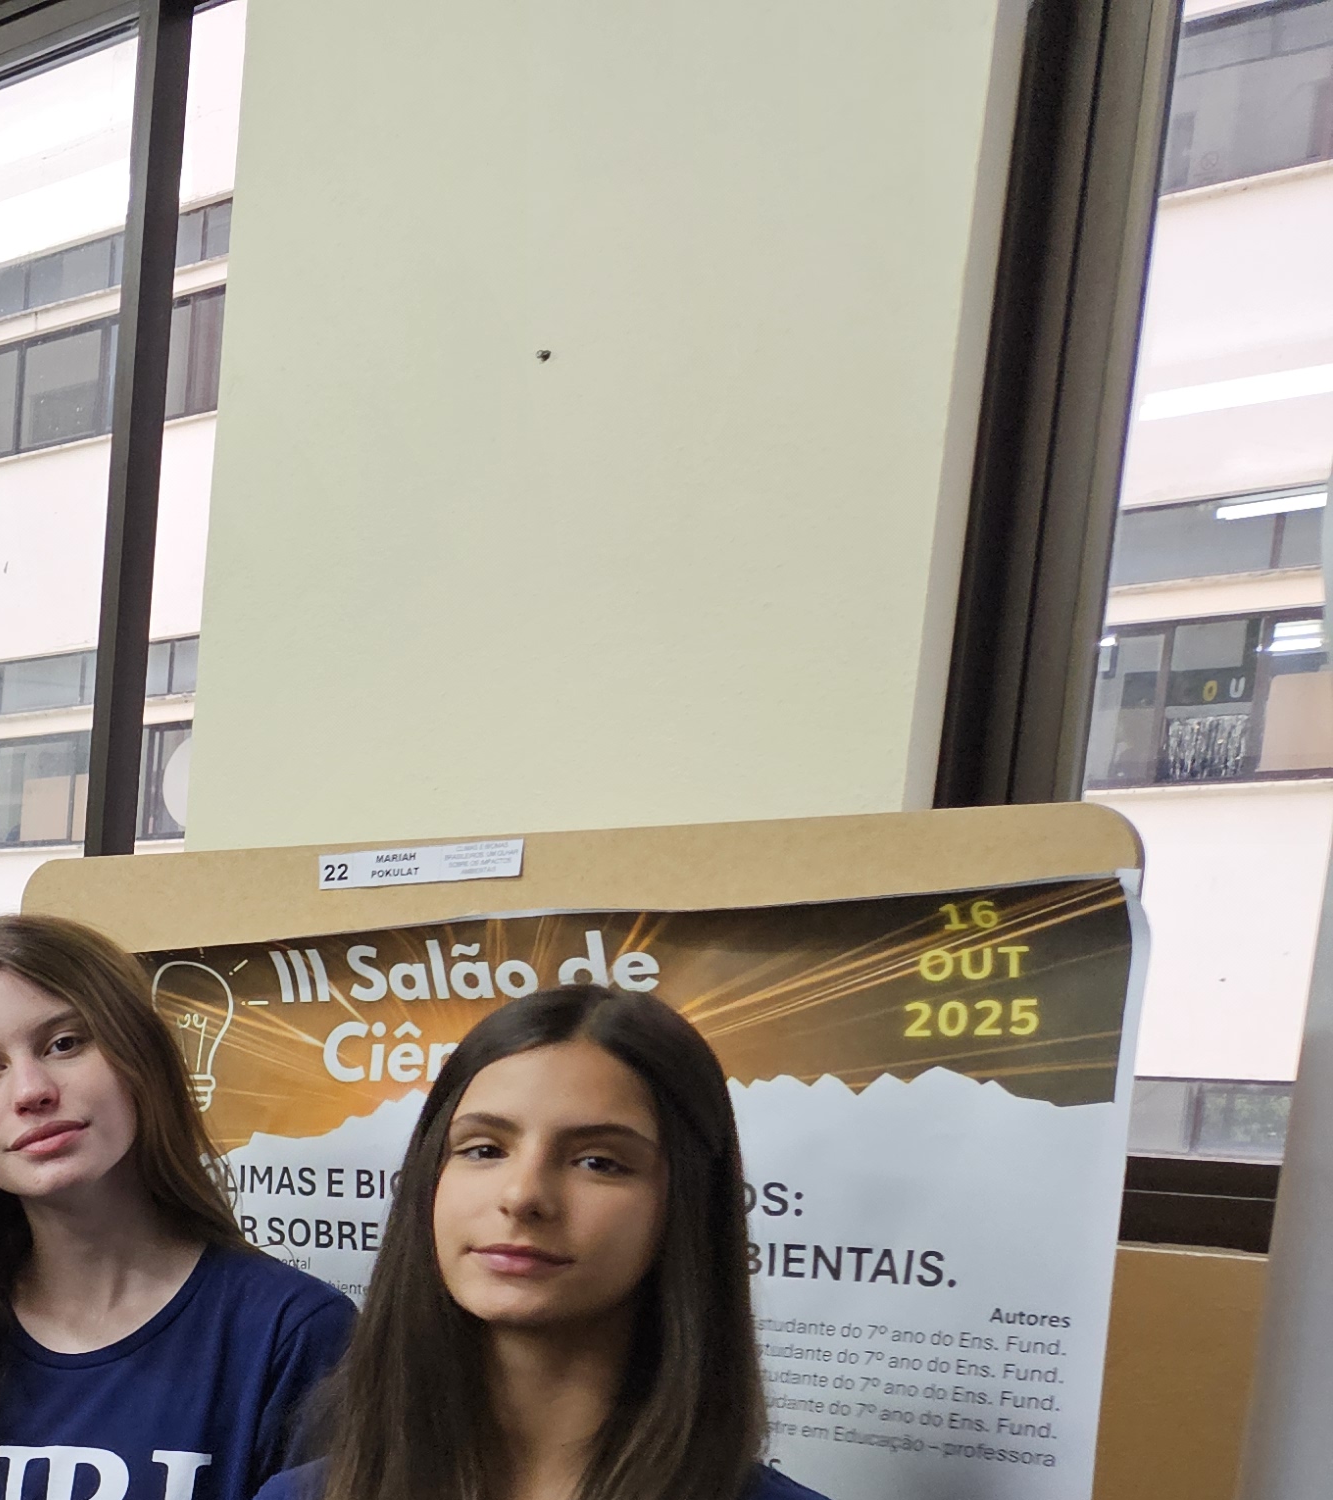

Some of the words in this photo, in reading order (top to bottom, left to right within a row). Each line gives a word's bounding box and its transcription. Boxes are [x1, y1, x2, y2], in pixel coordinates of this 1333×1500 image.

[323, 863, 349, 882] 22
[375, 852, 417, 864] MARIAH
[938, 900, 999, 931] 16
[269, 949, 331, 1003] III
[346, 939, 538, 1002] Salão
[558, 930, 661, 993] de
[918, 946, 1030, 982] OUT
[903, 997, 1039, 1038] 2025
[326, 1168, 345, 1198] E
[266, 1216, 380, 1251] SOBRE
[747, 1242, 958, 1289] BIENTAIS.
[989, 1307, 1072, 1329] Autores
[840, 1323, 862, 1339] do
[891, 1330, 926, 1345] ano
[930, 1329, 954, 1347] do
[959, 1332, 1000, 1351] Ens.
[1006, 1336, 1068, 1357] Fund.
[837, 1348, 860, 1365] do
[888, 1354, 923, 1371] ano
[927, 1355, 950, 1374] do
[956, 1359, 996, 1379] Ens.
[1003, 1363, 1065, 1384] Fund.
[833, 1375, 855, 1391] do
[884, 1381, 919, 1398] ano
[923, 1382, 947, 1400] do
[953, 1386, 993, 1406] Ens.
[999, 1390, 1061, 1412] Fund.
[829, 1400, 852, 1417] do
[880, 1408, 915, 1424] ano
[919, 1409, 943, 1428] do
[948, 1412, 989, 1433] Ens.
[996, 1417, 1058, 1439] Fund.
[801, 1425, 829, 1440] em
[834, 1426, 924, 1453] Educação
[943, 1440, 1057, 1468] professora
